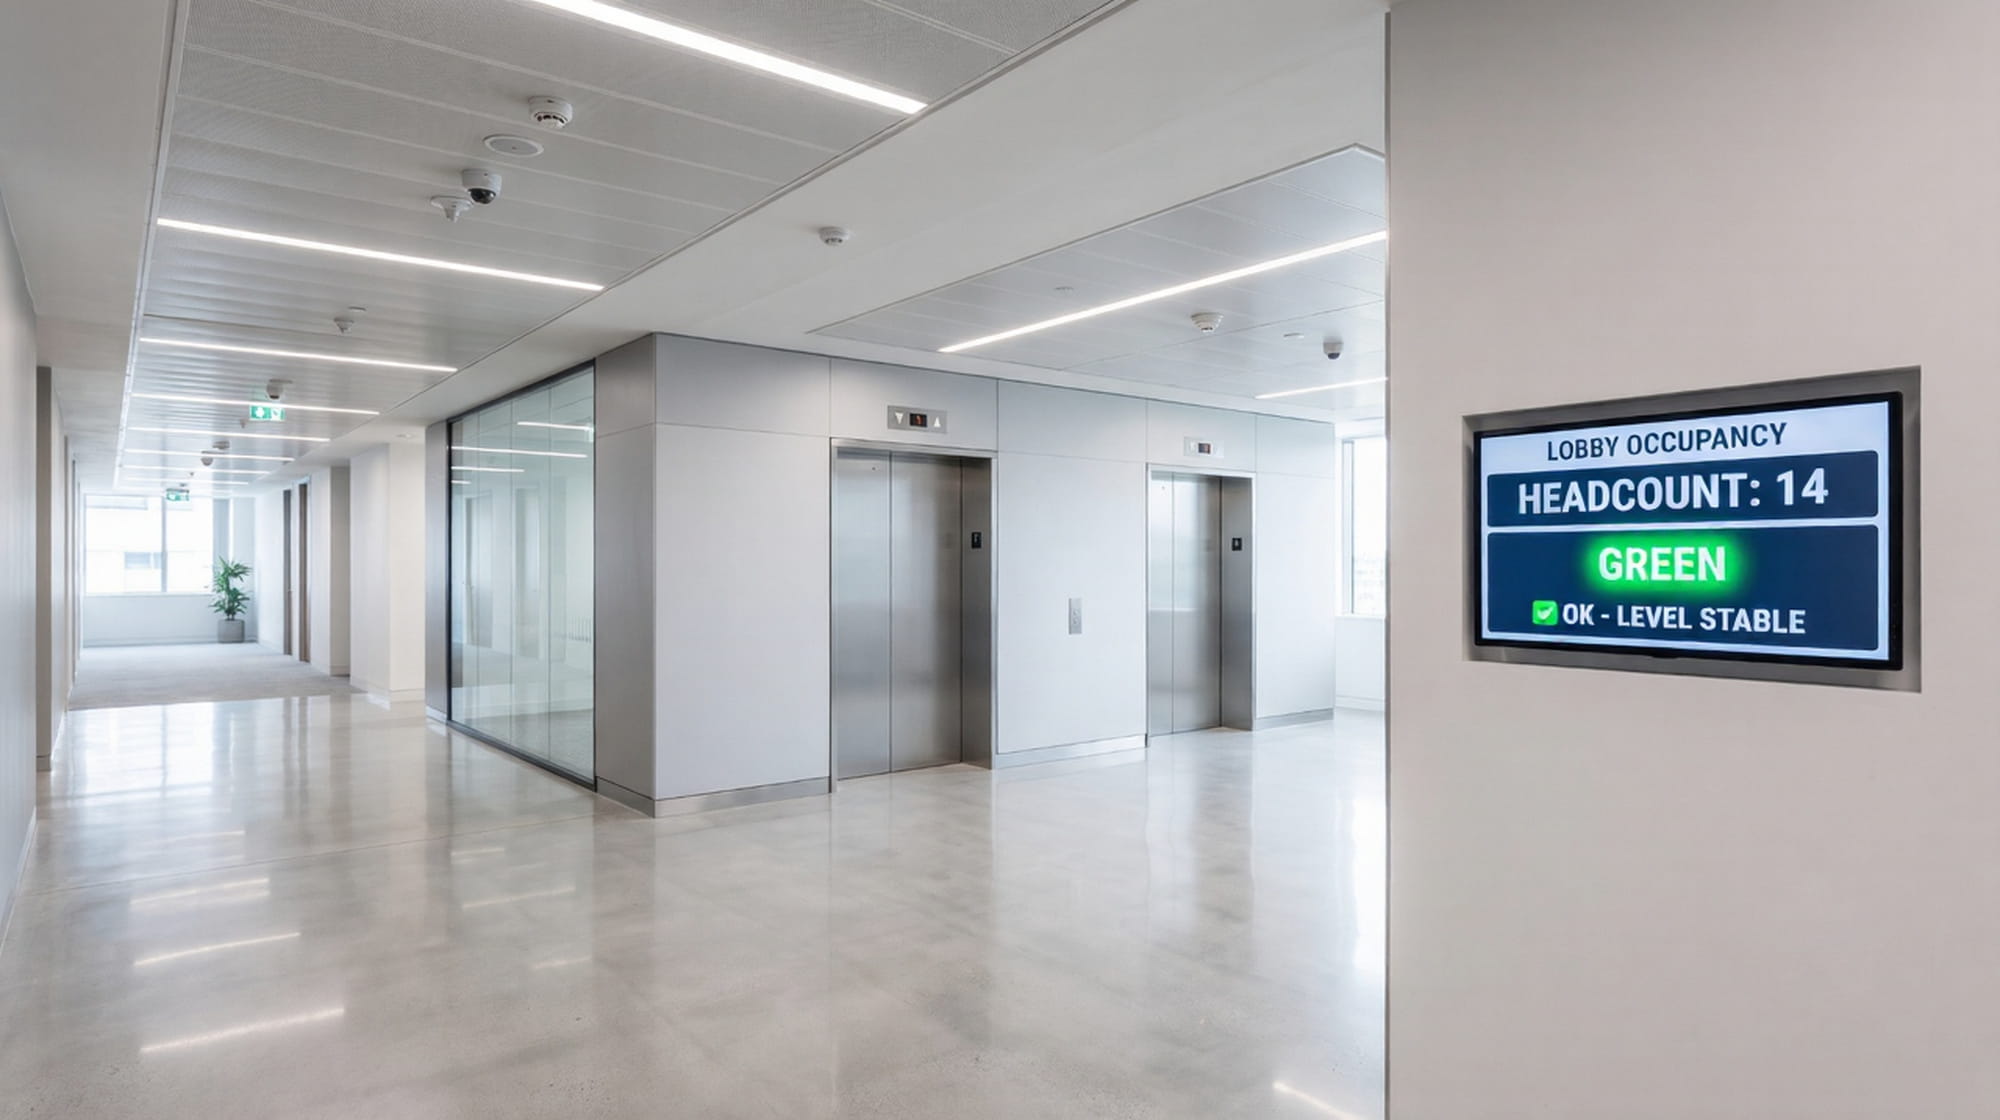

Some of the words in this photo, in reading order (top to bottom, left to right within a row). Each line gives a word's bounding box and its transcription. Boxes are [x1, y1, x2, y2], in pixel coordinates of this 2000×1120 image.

[1547, 437, 1619, 461] LOBBY
[1627, 422, 1787, 455] OCCUPANCY
[1518, 472, 1761, 514] HEADCOUNT:
[1776, 468, 1828, 505] 14
[1600, 546, 1726, 581] GREEN
[1562, 603, 1595, 626] OK
[1617, 605, 1692, 629] LEVEL
[1700, 608, 1806, 634] STABLE
